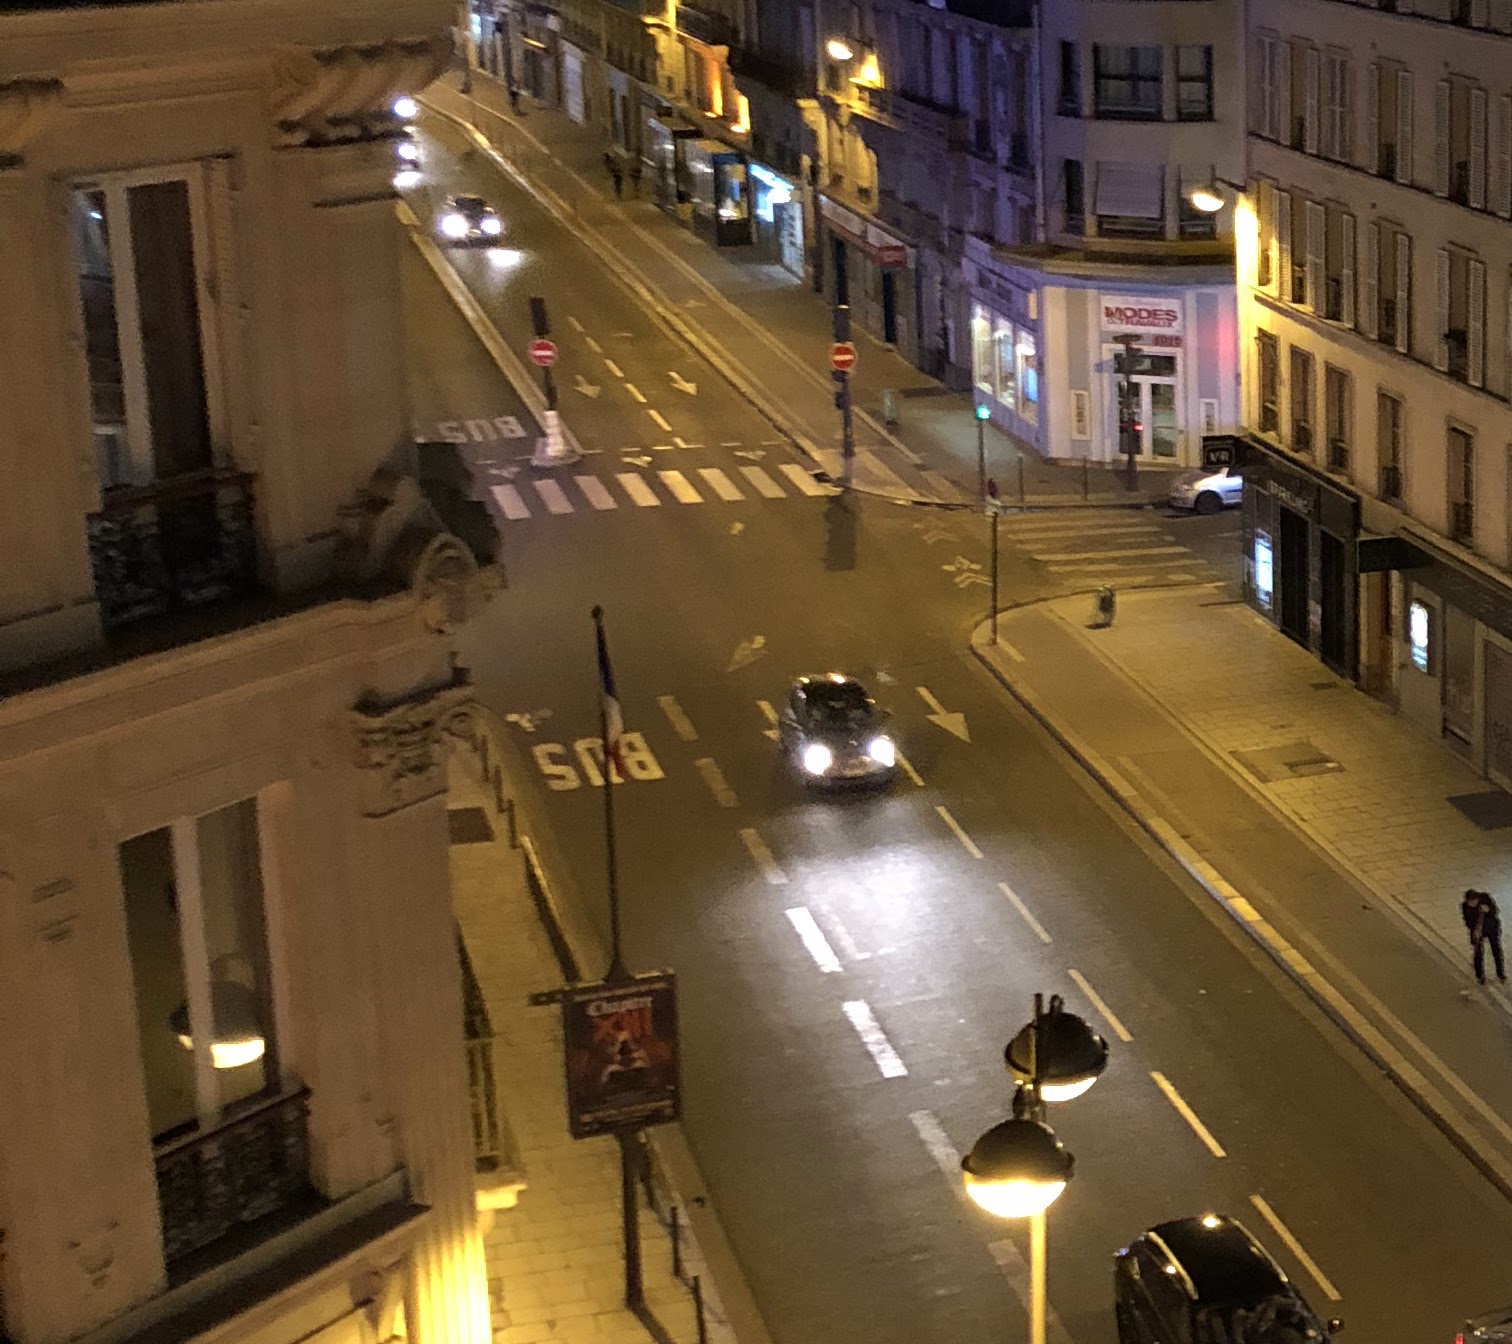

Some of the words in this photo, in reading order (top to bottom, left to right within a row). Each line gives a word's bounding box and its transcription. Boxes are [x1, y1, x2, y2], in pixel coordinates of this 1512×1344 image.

[1104, 306, 1178, 322] MODES
[438, 415, 527, 444] BUS
[532, 731, 666, 792] BUS
